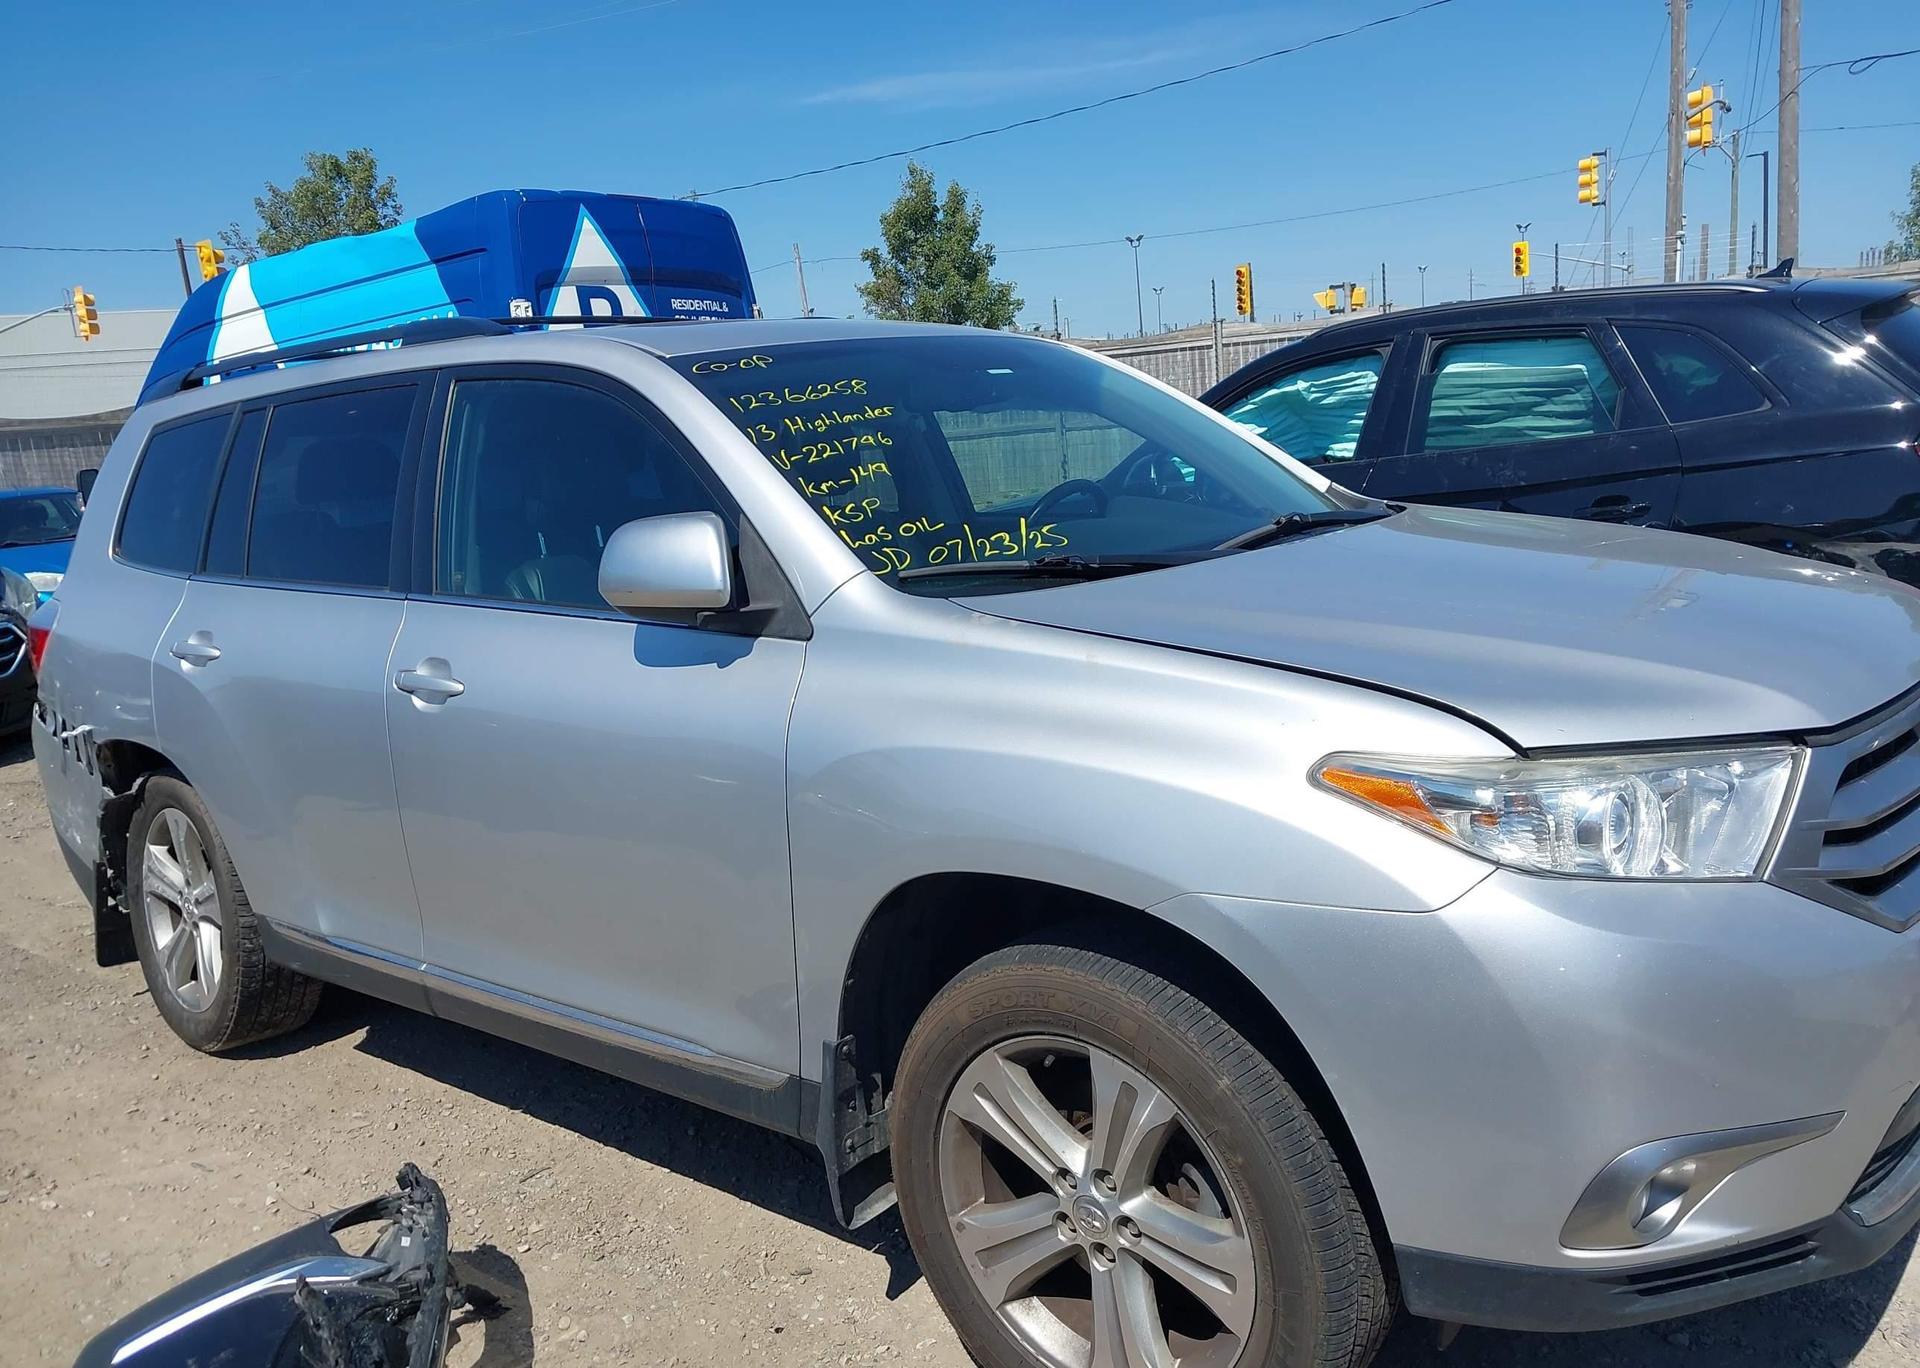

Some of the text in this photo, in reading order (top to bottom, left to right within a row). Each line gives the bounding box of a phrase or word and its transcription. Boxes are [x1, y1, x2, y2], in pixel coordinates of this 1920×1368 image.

[671, 299, 729, 312] RESIDENTIAL &
[729, 379, 868, 413] 12366258
[747, 405, 895, 445] 13 Highlander
[928, 517, 1069, 564] 07/23/25
[968, 990, 1057, 1019] SPORT
